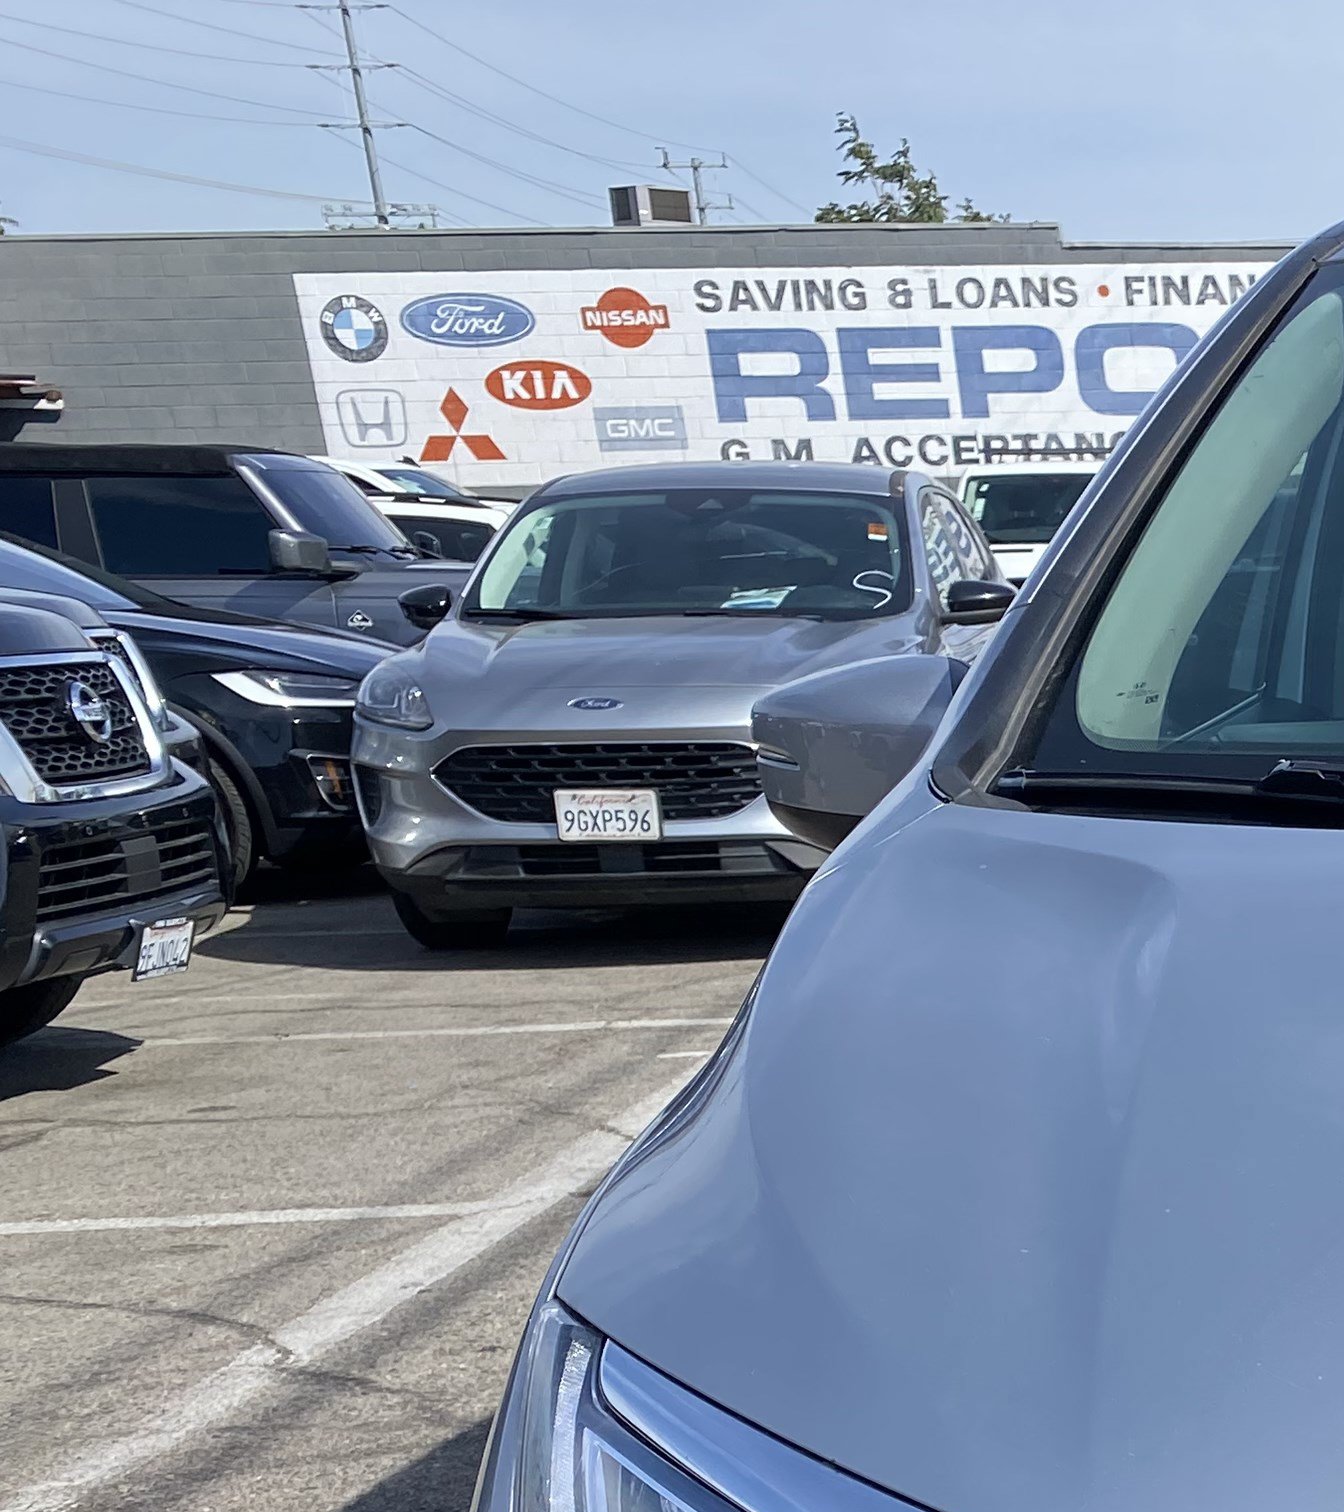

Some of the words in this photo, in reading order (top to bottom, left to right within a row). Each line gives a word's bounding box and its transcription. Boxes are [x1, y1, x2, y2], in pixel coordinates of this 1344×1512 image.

[693, 278, 867, 313] SAVING
[887, 277, 913, 310] &
[928, 274, 1078, 310] LOANS
[430, 305, 507, 335] Ford
[585, 308, 666, 328] NISSAN
[499, 369, 580, 400] KIA
[606, 418, 675, 439] GMC
[564, 809, 651, 833] 9GXP596
